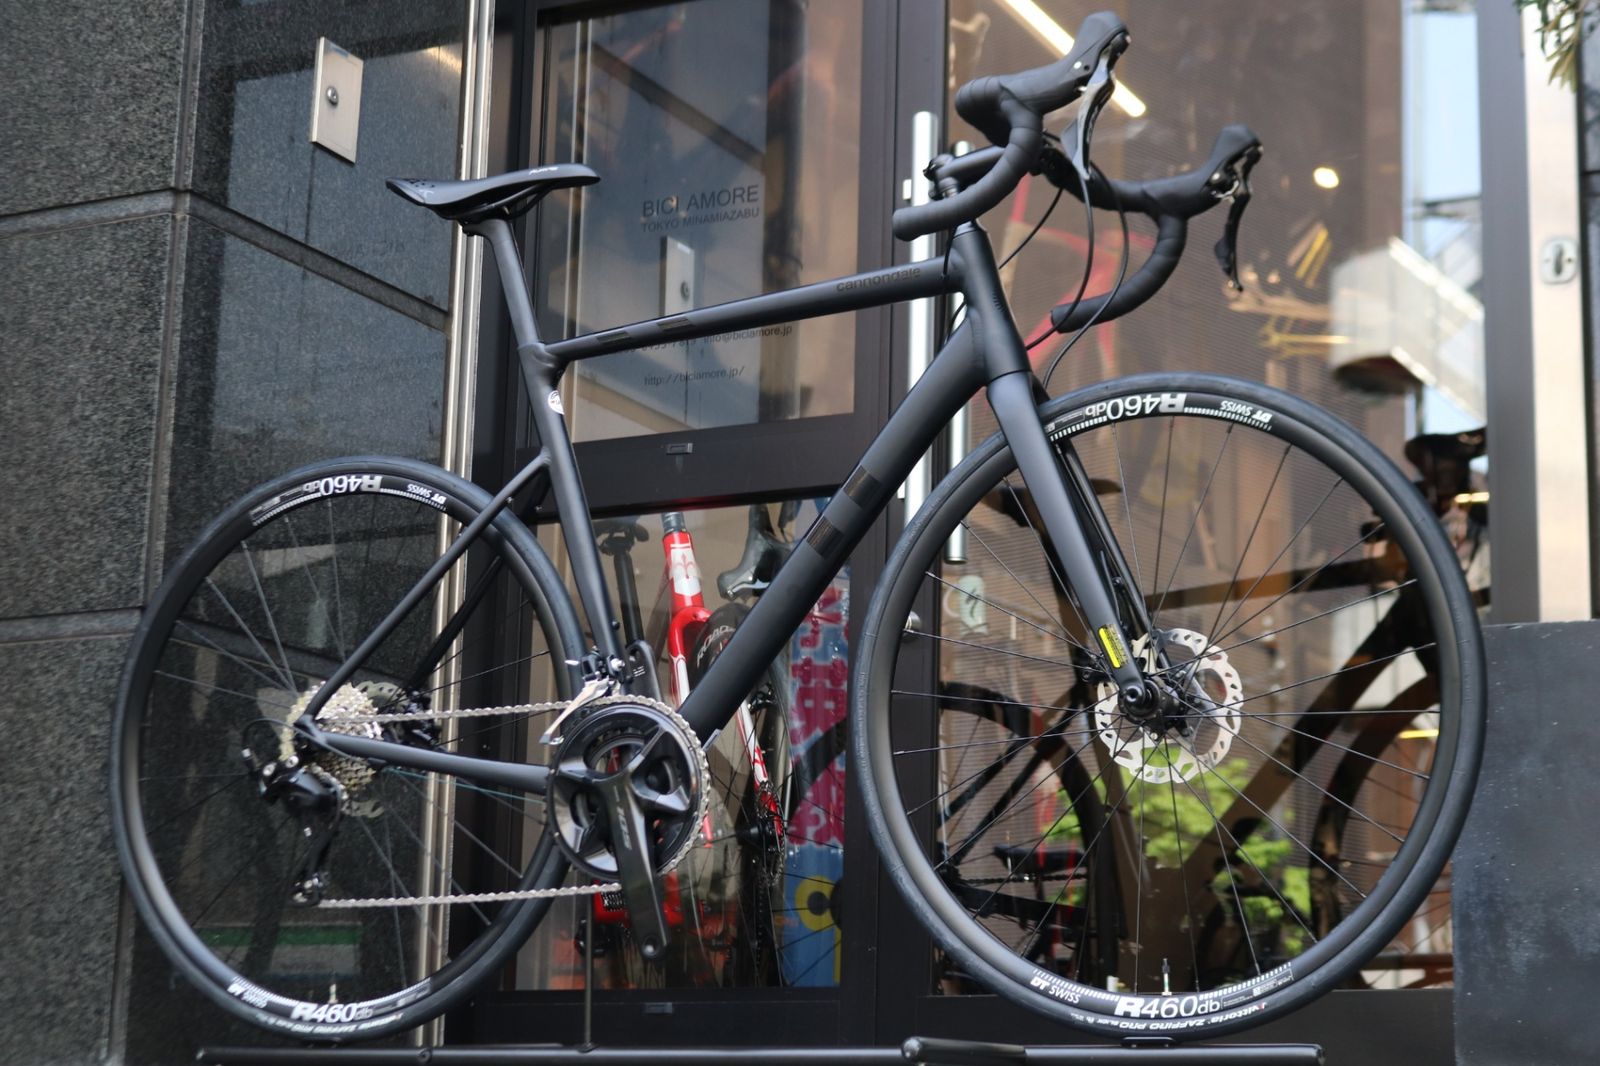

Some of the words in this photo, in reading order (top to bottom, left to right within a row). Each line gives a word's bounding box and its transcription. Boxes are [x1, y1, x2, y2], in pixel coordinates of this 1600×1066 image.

[642, 194, 680, 218] BICI
[686, 184, 760, 212] AMORE
[641, 218, 680, 233] TOKYO
[682, 207, 760, 228] MINAMIAZABU
[836, 267, 921, 292] cannondale
[644, 366, 745, 386] http://biciamore.jp/
[1220, 399, 1253, 417] SWISS
[1249, 409, 1273, 423] DT
[406, 483, 432, 499] SWISS
[1030, 976, 1049, 991] DT
[1048, 984, 1081, 1004] SWISS
[1119, 1020, 1147, 1031] PRO
[1150, 1018, 1206, 1031] ZAFFIRO
